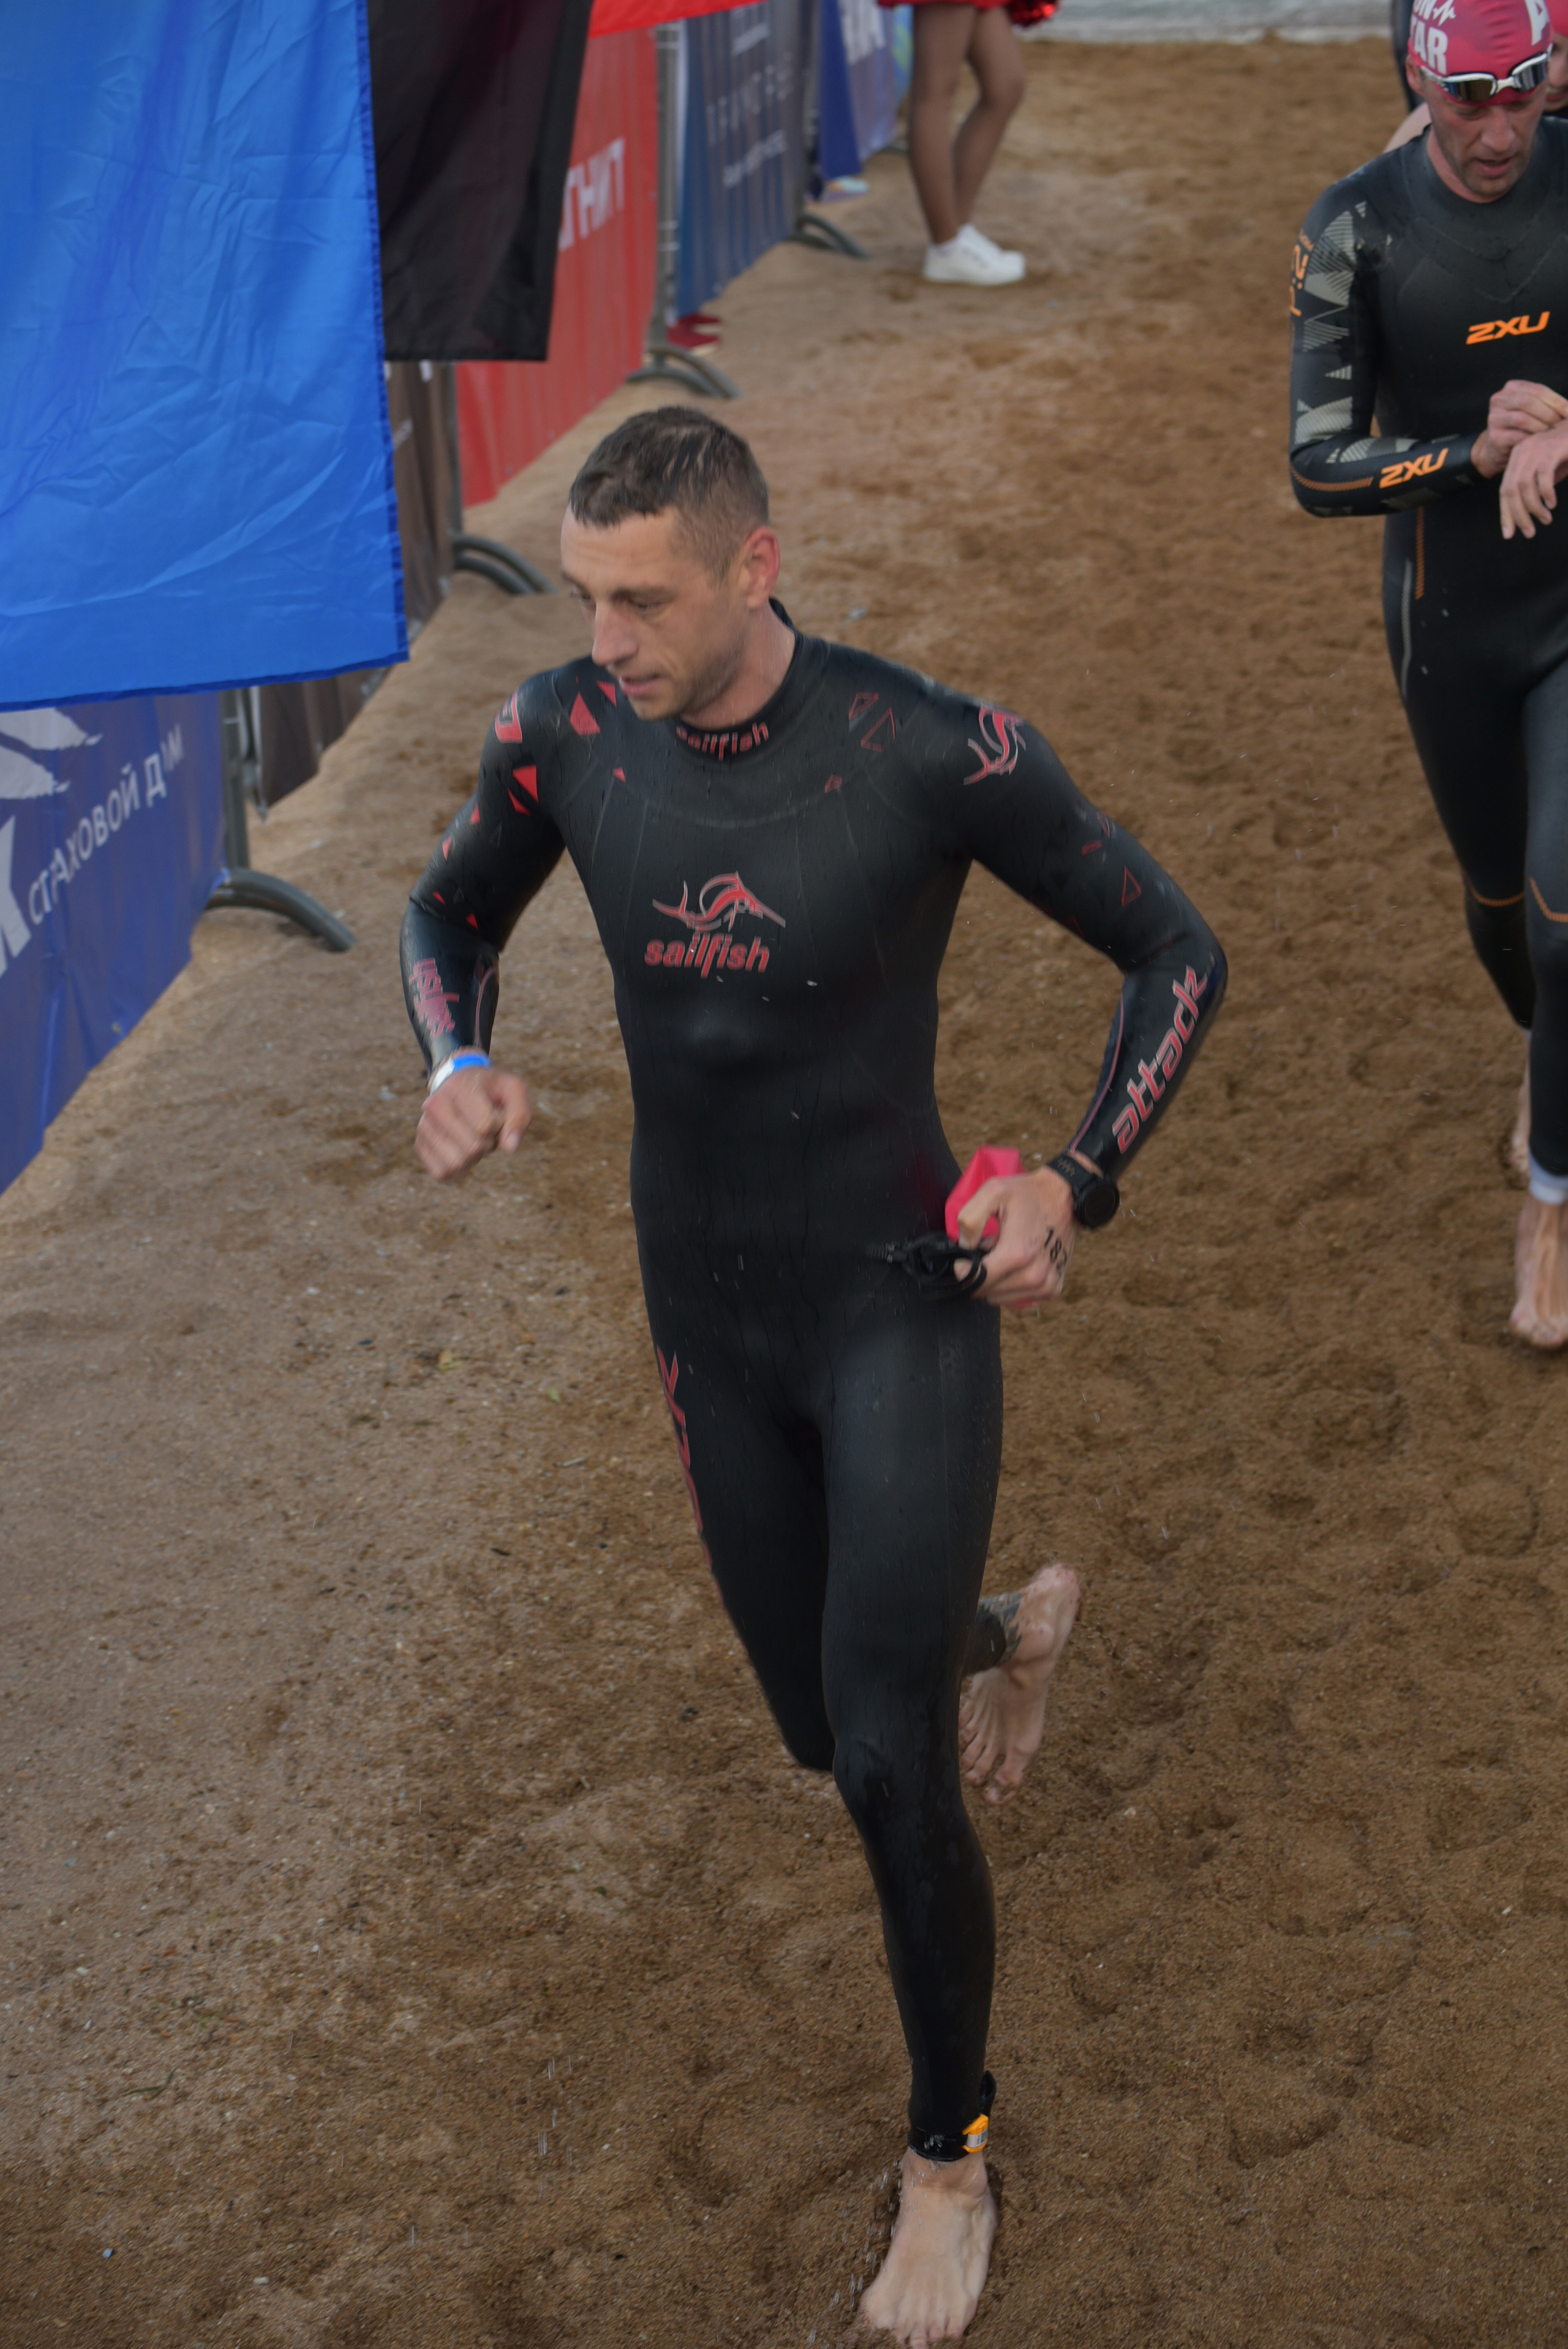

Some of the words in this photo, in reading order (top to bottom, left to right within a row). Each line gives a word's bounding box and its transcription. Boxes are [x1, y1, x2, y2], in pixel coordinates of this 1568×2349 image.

[1466, 311, 1550, 345] 2XU
[1379, 448, 1449, 488] 2XU
[644, 932, 770, 979] sailfish
[1112, 966, 1208, 1155] attack
